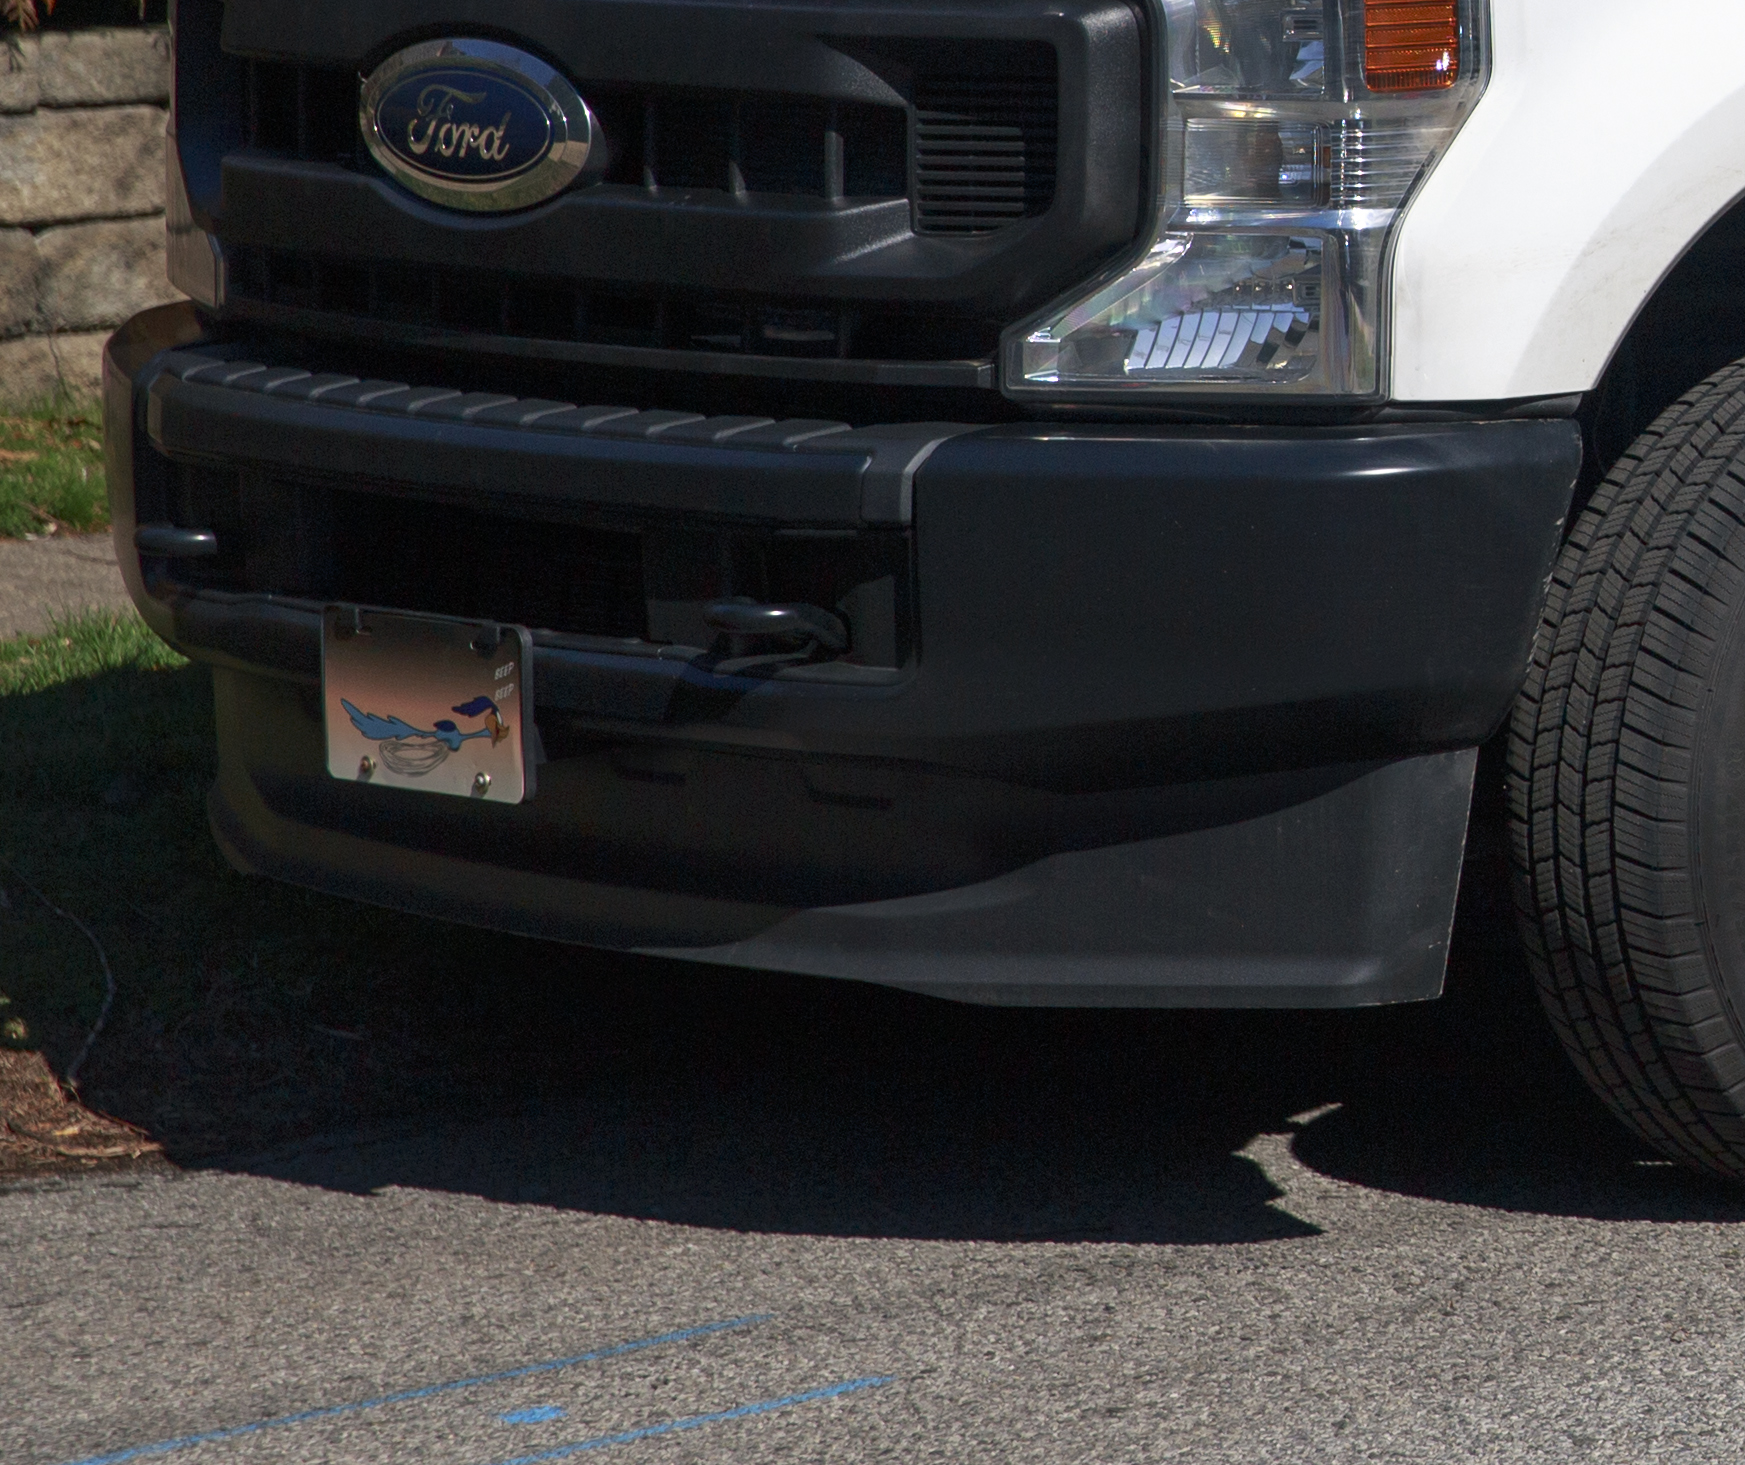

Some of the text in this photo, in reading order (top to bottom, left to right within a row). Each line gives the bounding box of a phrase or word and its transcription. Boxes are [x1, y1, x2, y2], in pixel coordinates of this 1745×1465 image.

[406, 84, 511, 161] Ford
[494, 661, 515, 680] BEEP
[494, 683, 515, 701] BEEP
